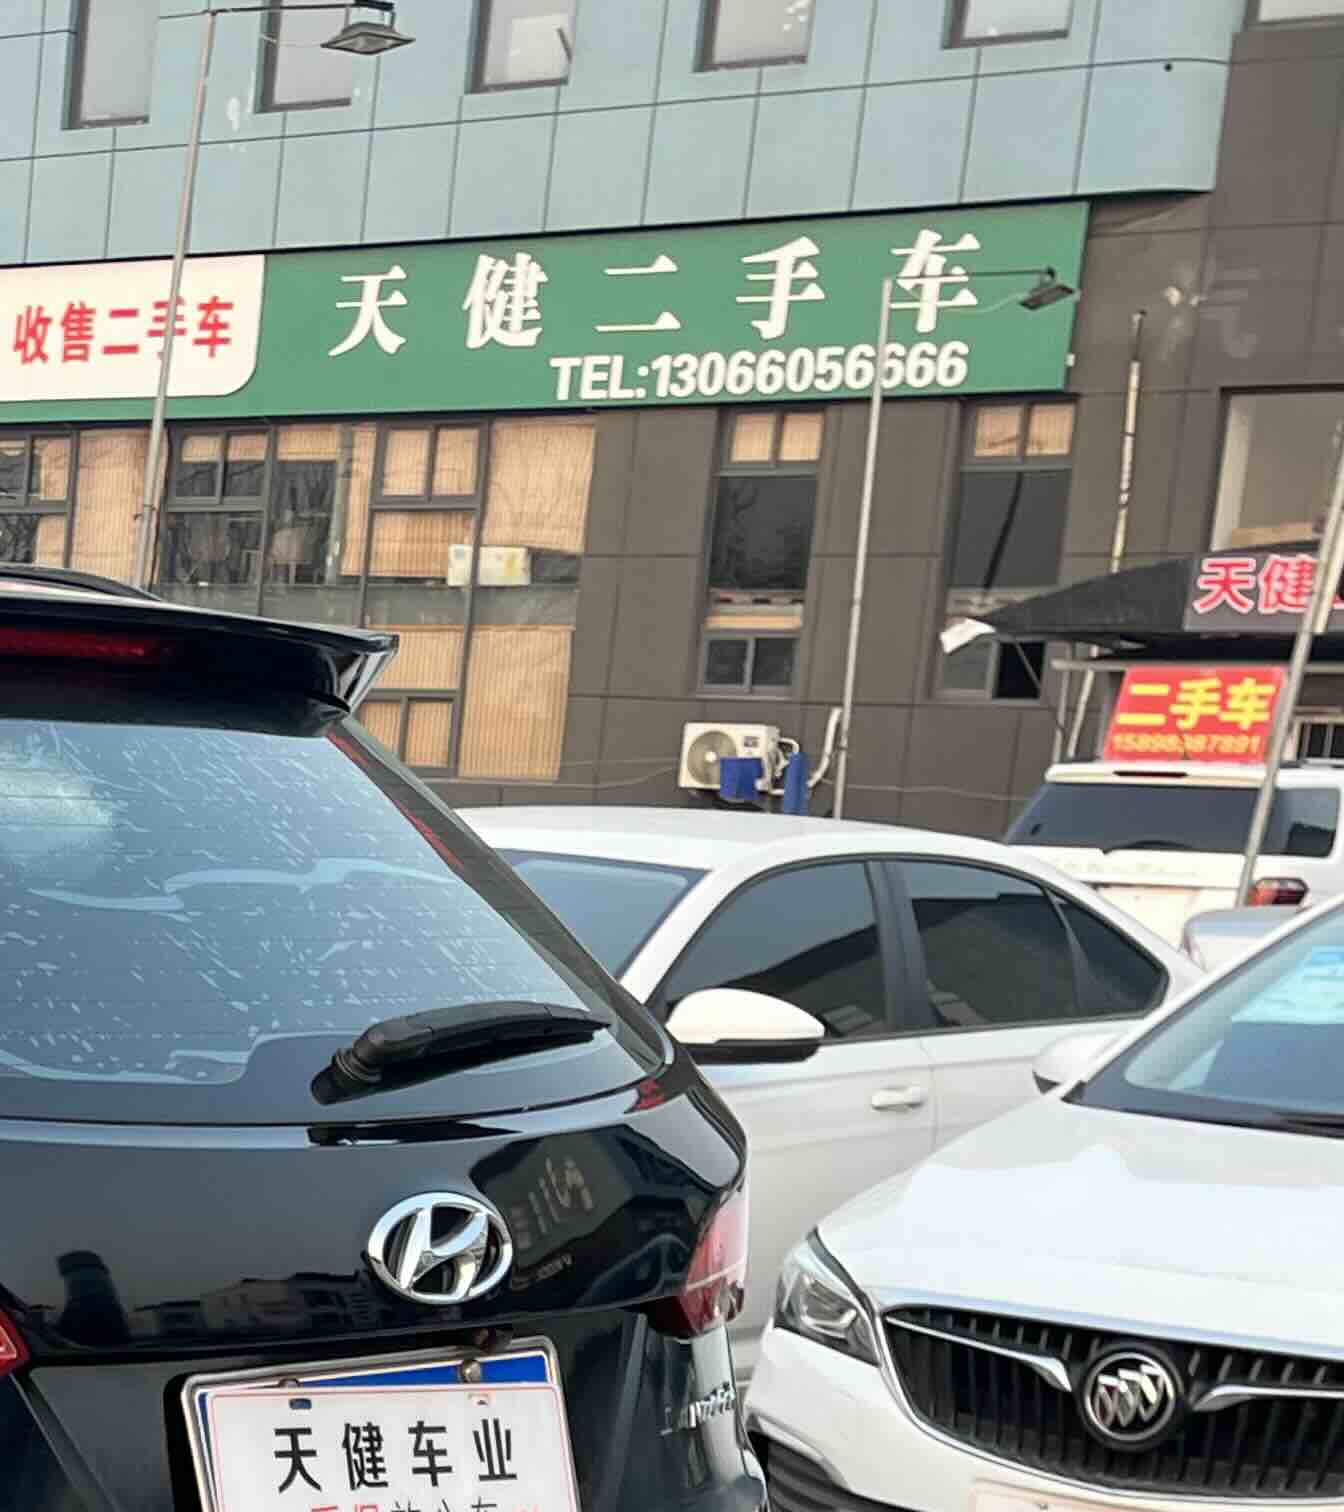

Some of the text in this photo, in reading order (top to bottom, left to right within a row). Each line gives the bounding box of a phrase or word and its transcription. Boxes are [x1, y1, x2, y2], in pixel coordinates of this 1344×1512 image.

[328, 229, 980, 357] 天健二手车
[550, 341, 969, 401] TEL:13066056666
[1192, 553, 1344, 614] 天健
[1115, 677, 1277, 730] 二手车
[273, 1418, 518, 1494] 天健车业
